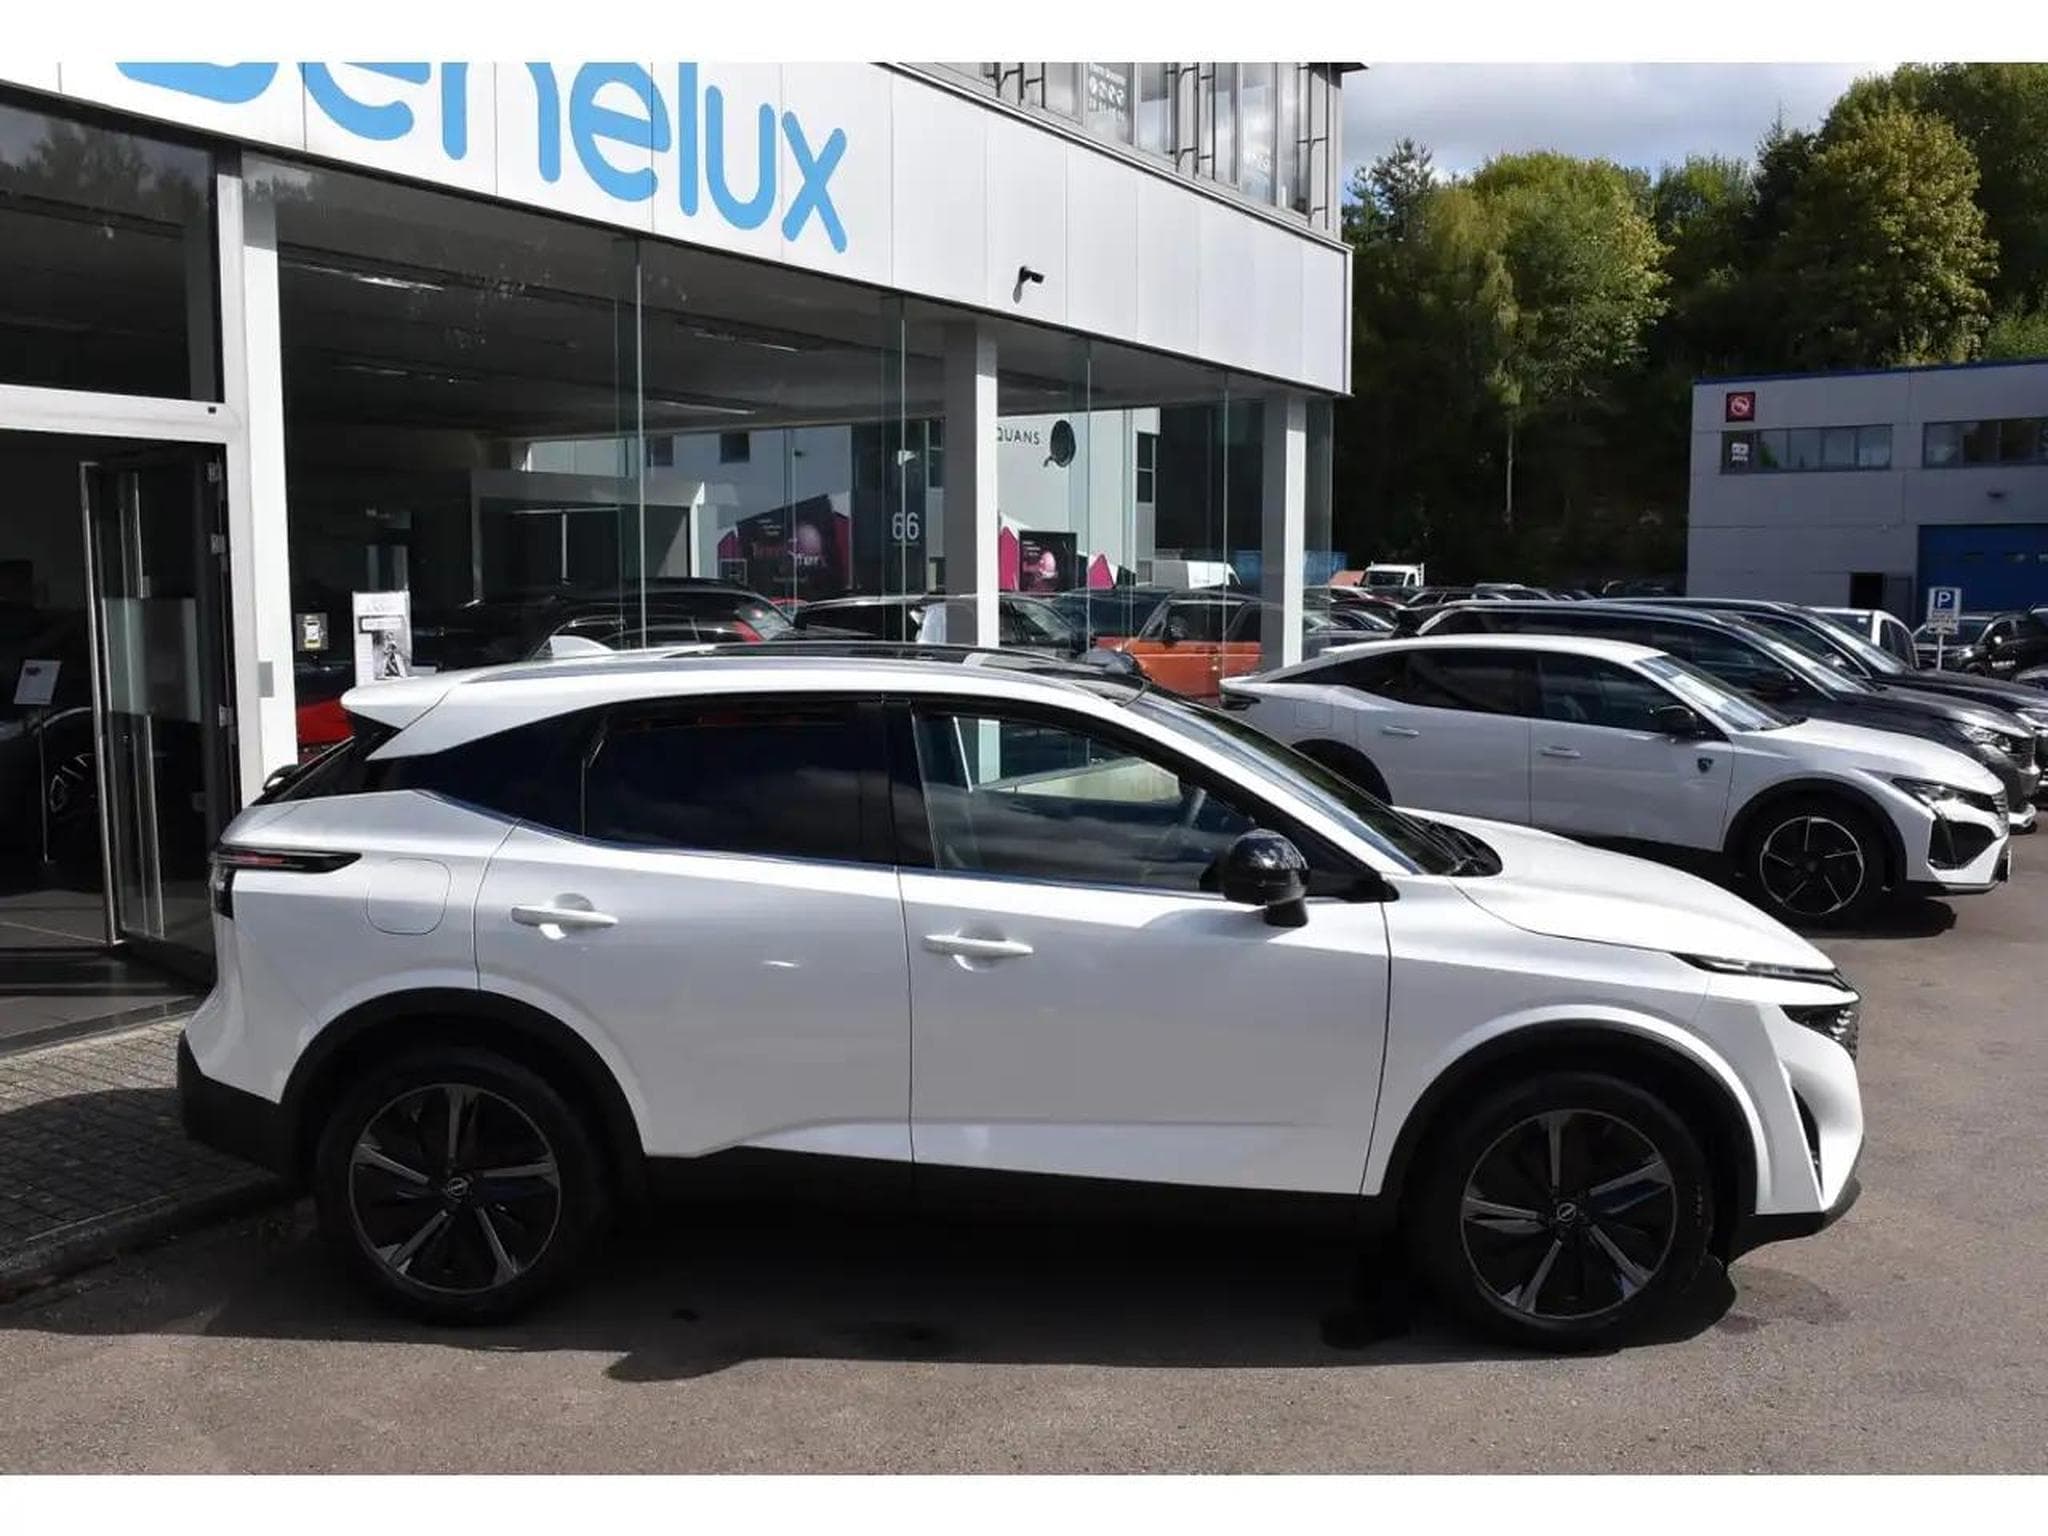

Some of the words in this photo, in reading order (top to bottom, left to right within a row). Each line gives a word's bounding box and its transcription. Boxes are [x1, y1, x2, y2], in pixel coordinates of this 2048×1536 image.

[114, 61, 847, 254] enelux
[891, 511, 920, 541] 66
[1937, 591, 1952, 609] P
